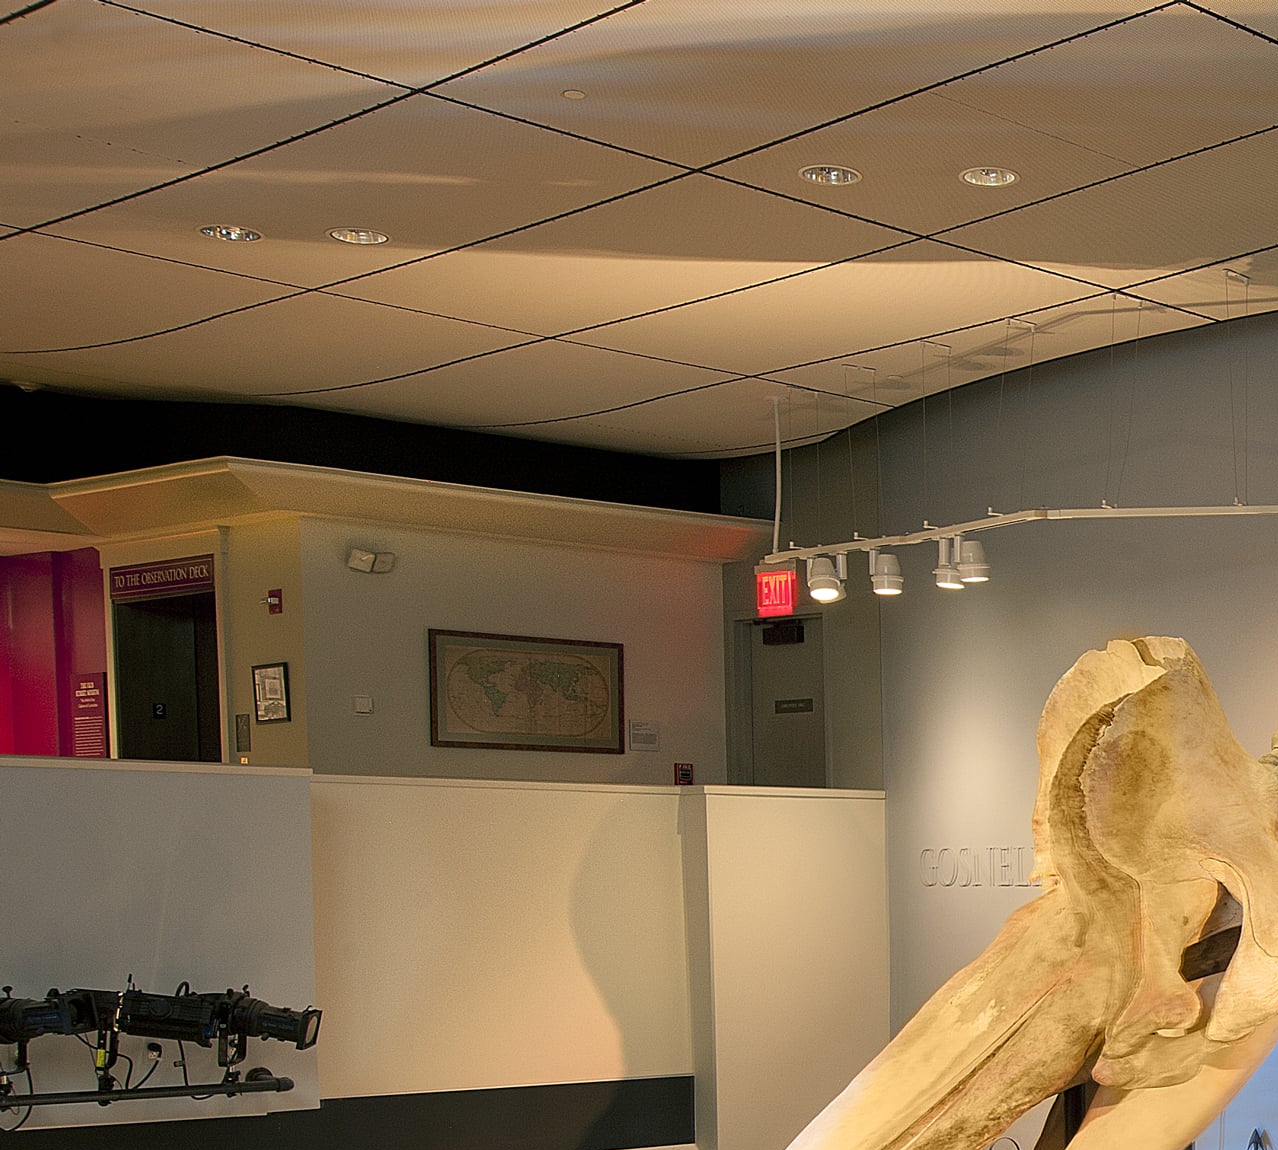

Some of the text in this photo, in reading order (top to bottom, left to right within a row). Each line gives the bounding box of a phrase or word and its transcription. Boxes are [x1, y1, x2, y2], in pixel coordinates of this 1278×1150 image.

[114, 565, 209, 588] TO THE OBSERVATION DECK
[762, 574, 787, 605] EXIT
[156, 704, 164, 715] 2
